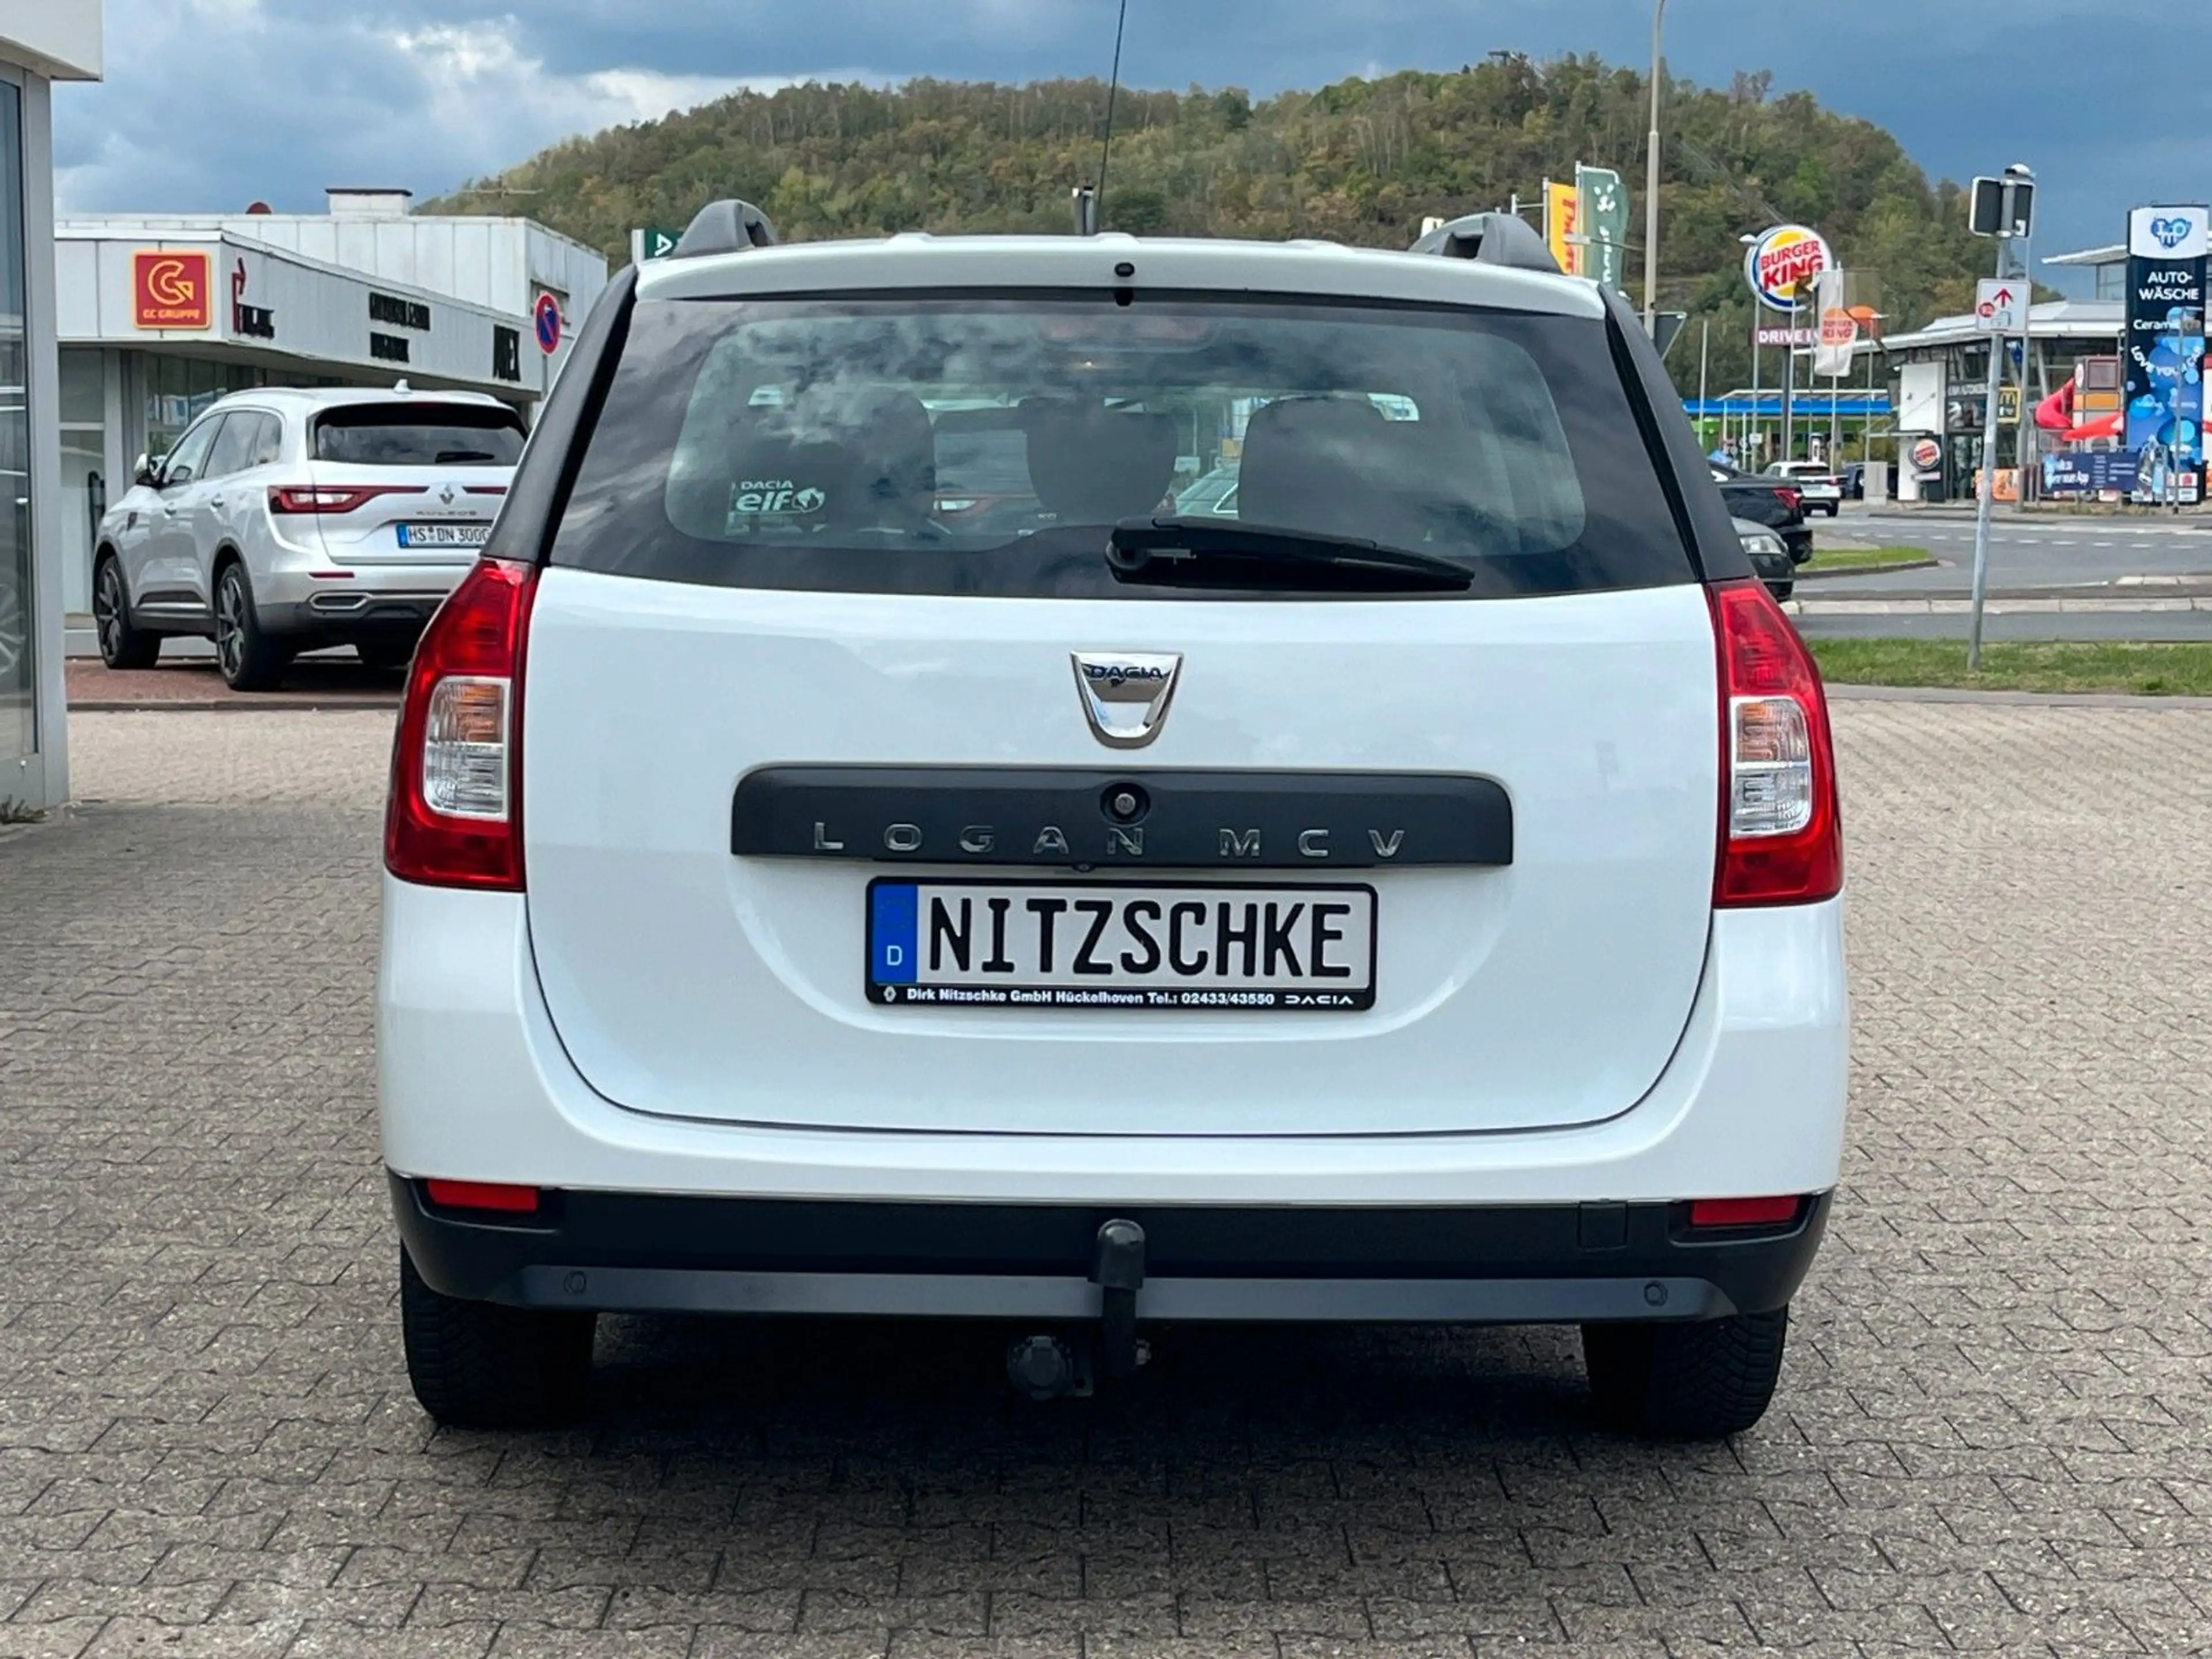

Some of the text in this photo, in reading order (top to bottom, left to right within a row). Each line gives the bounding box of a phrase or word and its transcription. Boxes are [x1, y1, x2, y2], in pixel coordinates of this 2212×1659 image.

[1761, 240, 1820, 270] BURGER
[1763, 255, 1824, 290] KING
[2147, 271, 2194, 283] AUTO-
[2138, 286, 2199, 300] WÄSCHE
[1758, 330, 1802, 343] DRIVE
[741, 480, 794, 490] DACIA
[736, 491, 793, 512] elf
[1089, 666, 1163, 679] DACIA
[814, 821, 1404, 857] LOGAN MCV
[929, 896, 1351, 978] NITZSCHKE
[886, 945, 903, 967] D
[907, 988, 935, 1001] Dirk
[940, 989, 1006, 1002] Nitzschke
[1010, 990, 1052, 1003] GmbH
[1056, 990, 1143, 1003] Hückelhoven
[1181, 993, 1275, 1006] 02433/43550
[1284, 995, 1354, 1005] DACIA
